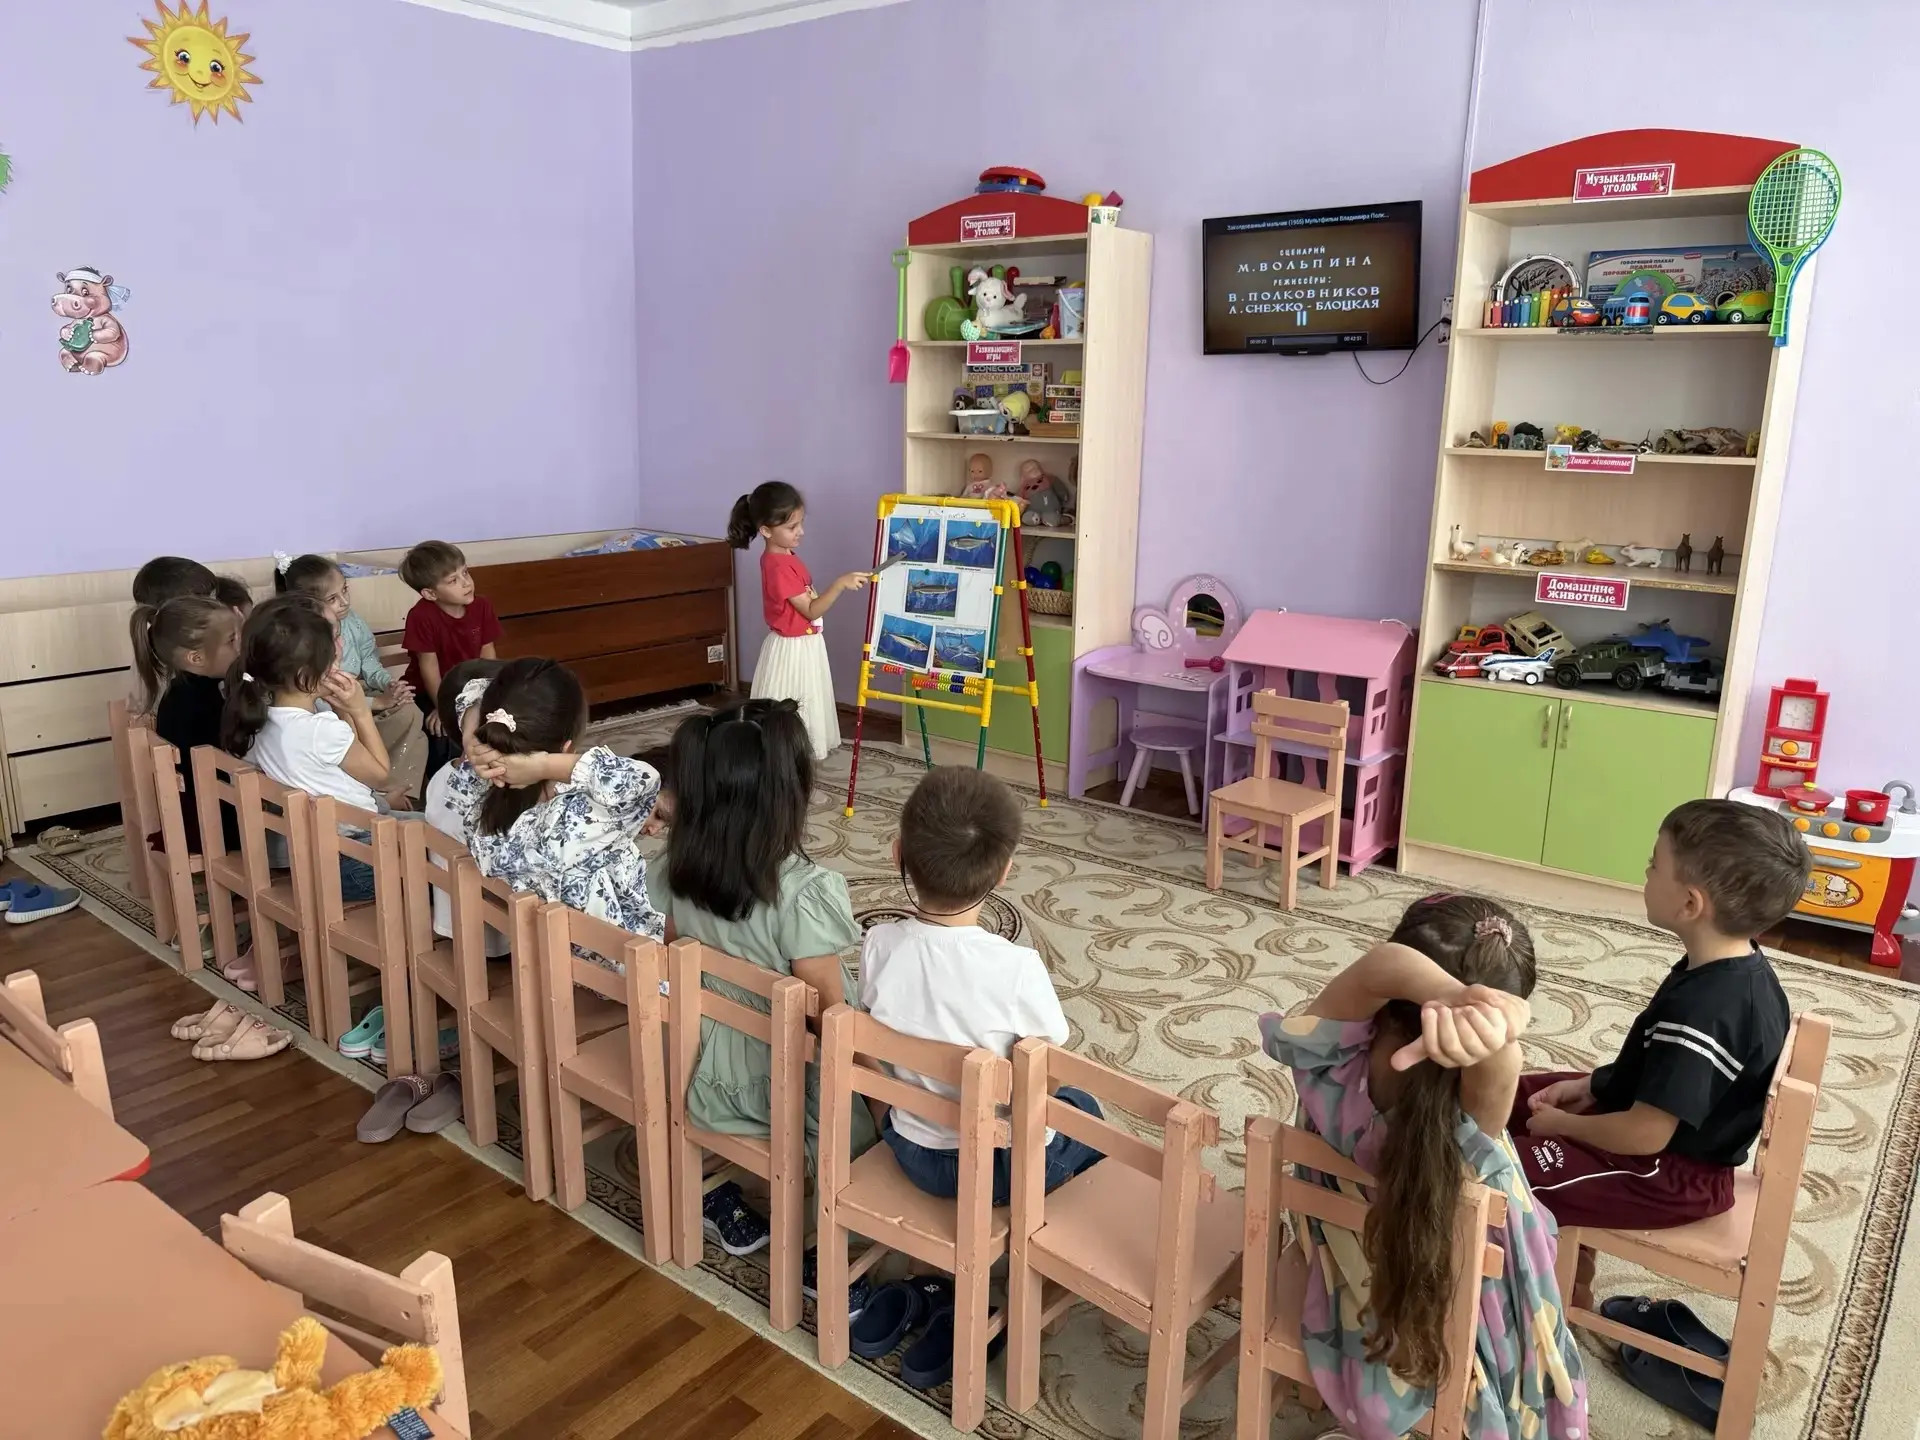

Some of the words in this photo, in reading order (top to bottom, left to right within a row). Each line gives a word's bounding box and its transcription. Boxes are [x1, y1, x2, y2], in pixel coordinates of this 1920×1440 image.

[1585, 168, 1659, 186] Музыкальный
[1602, 183, 1638, 196] уголок
[964, 216, 1011, 230] Спортивный
[974, 227, 1000, 238] уголок
[1279, 245, 1326, 257] СЦЕНАРИЙ
[975, 345, 1013, 354] Развивающие
[985, 353, 1002, 362] игры
[972, 364, 1023, 372] CONECTOR
[1567, 456, 1591, 465] Дикие
[1591, 458, 1632, 467] животные
[1546, 578, 1615, 594] Домашние
[1547, 590, 1616, 604] животные
